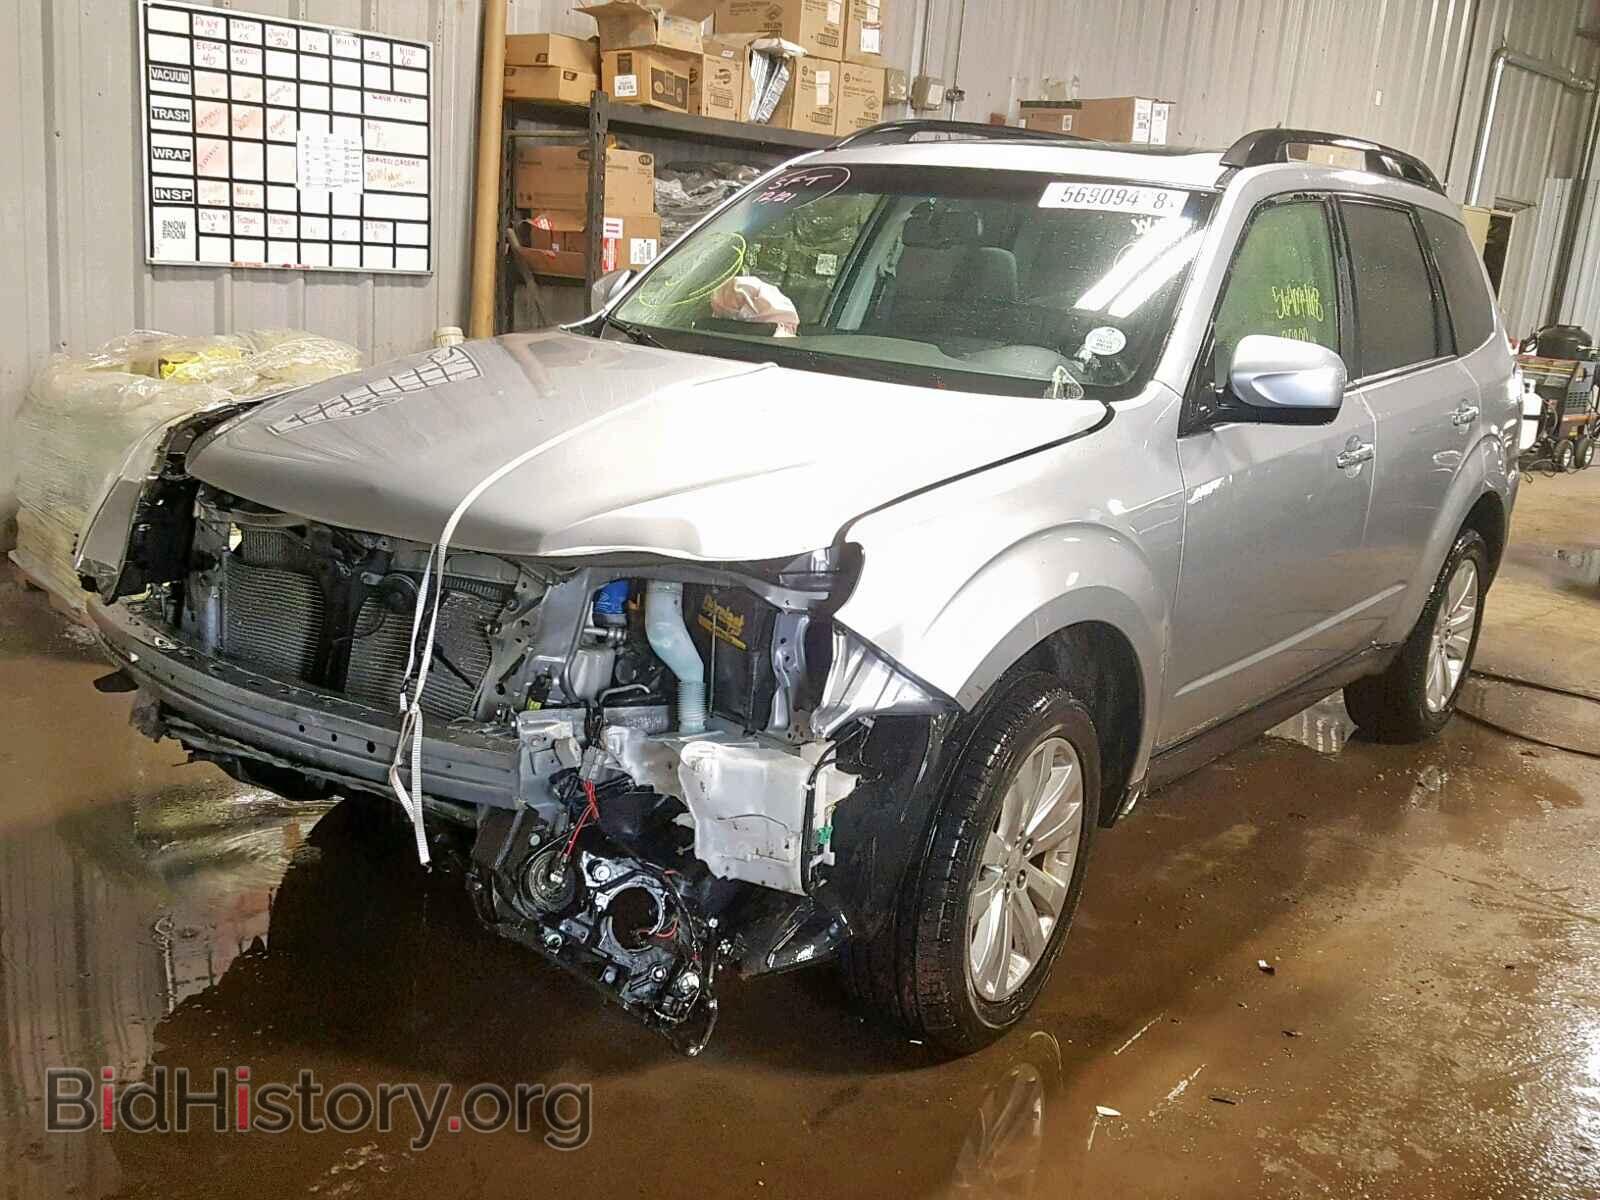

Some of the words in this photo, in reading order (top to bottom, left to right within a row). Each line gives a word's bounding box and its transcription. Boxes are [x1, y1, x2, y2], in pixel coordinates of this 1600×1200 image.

[151, 68, 189, 83] VACUUM
[152, 107, 189, 121] TRASH
[153, 148, 190, 161] WRAP
[155, 189, 192, 200] INSP
